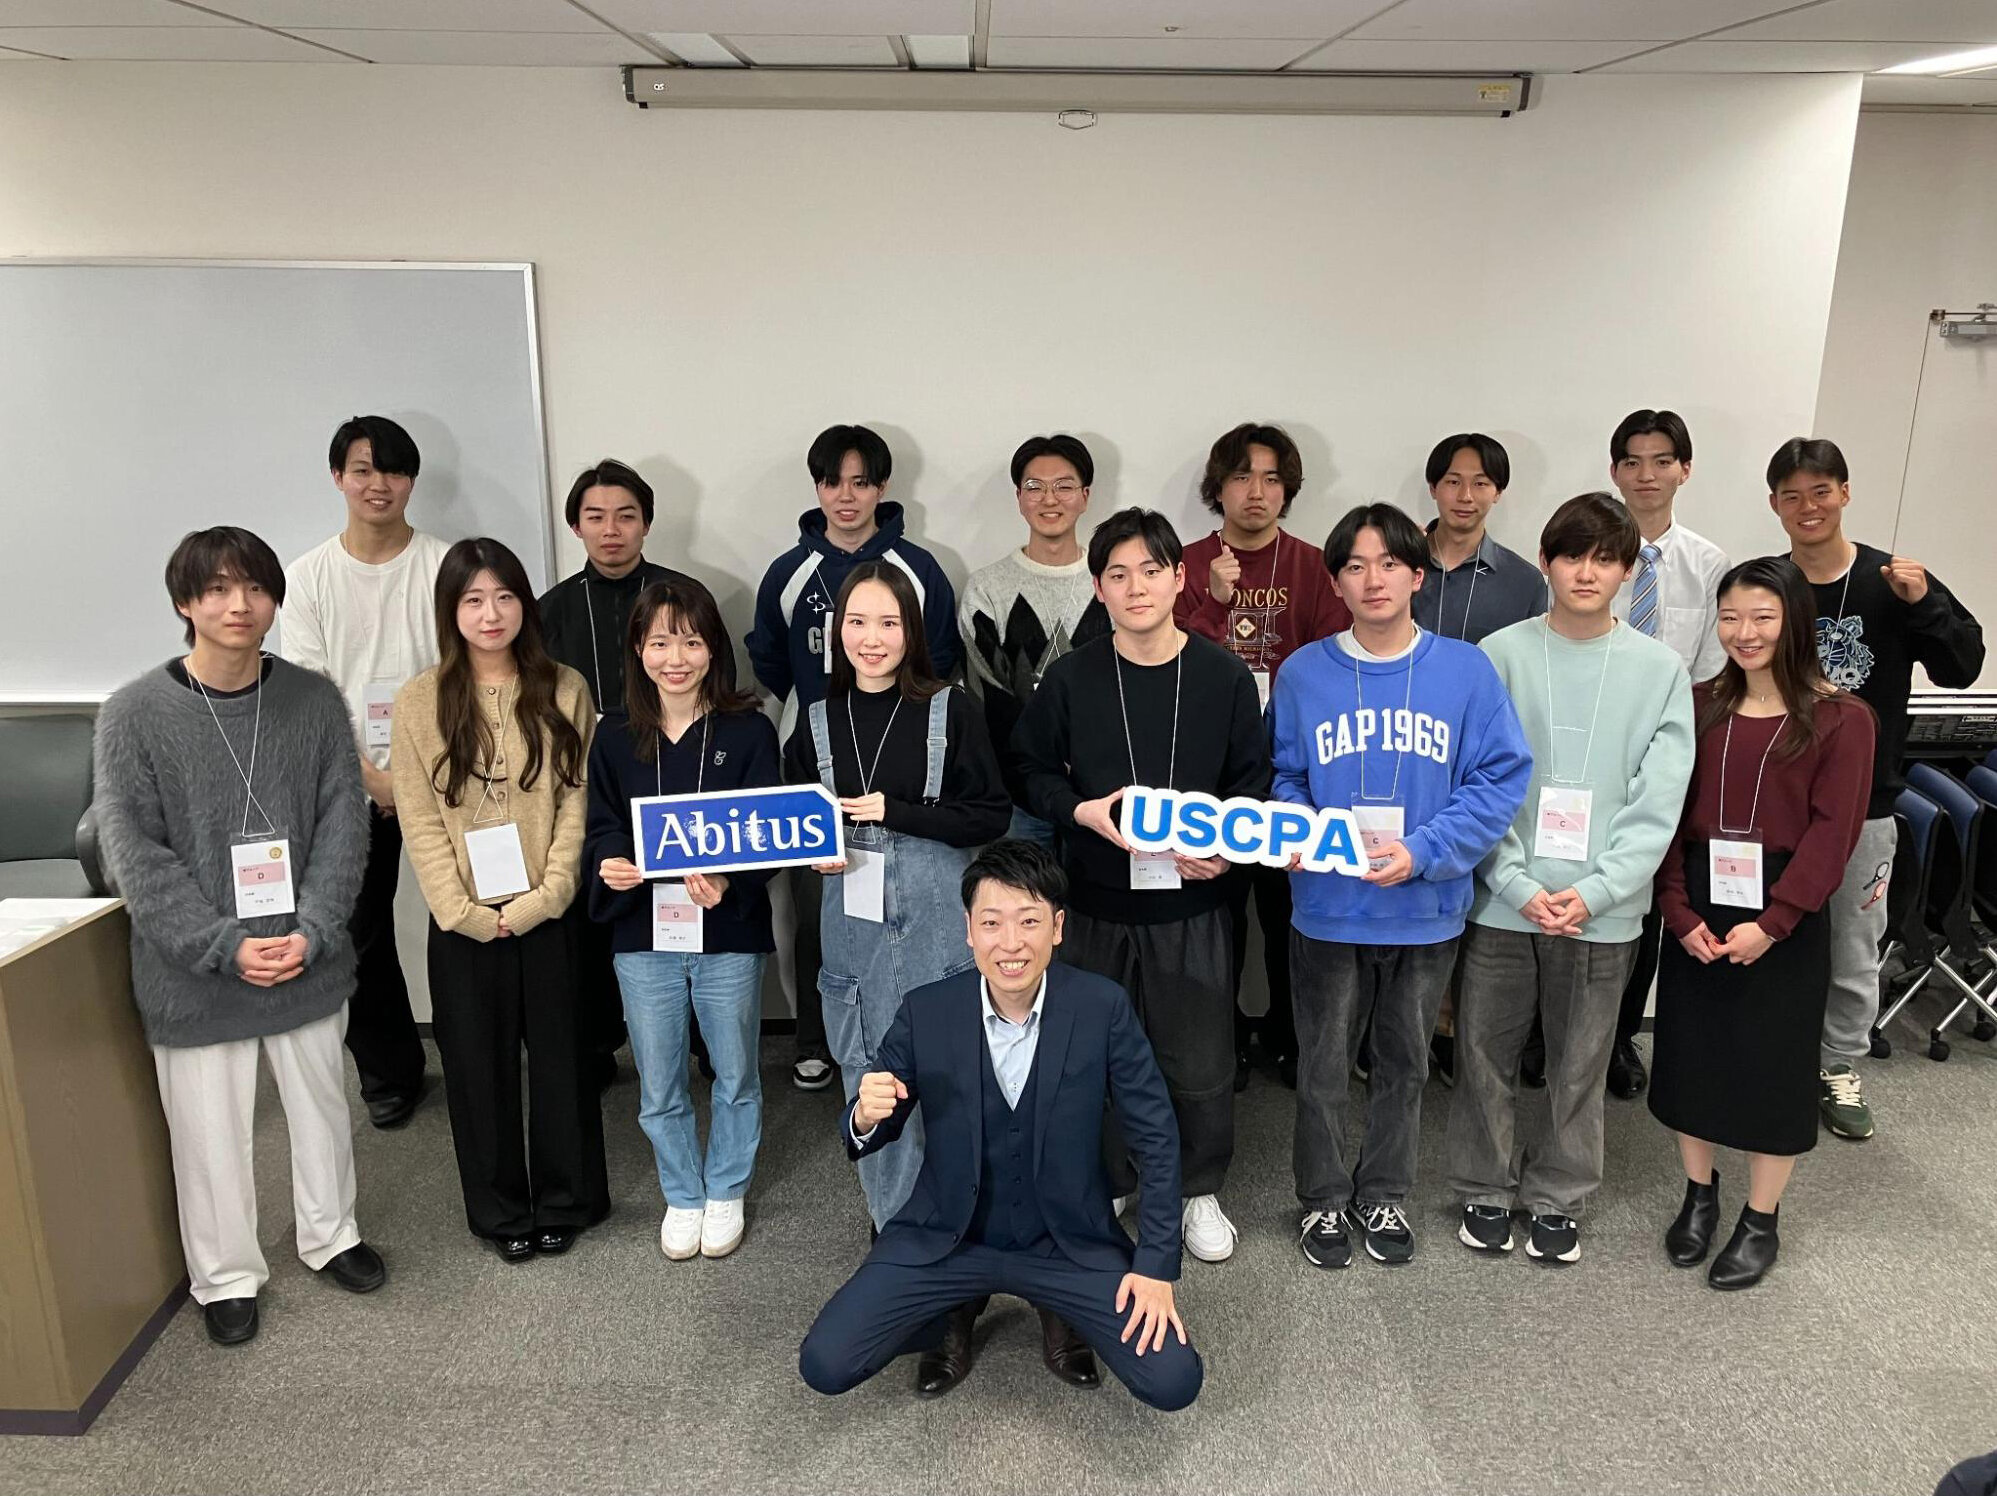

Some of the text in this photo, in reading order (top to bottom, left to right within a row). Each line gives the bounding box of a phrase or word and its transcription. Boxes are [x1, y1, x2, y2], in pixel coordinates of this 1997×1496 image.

[1205, 587, 1288, 607] ONCOS
[1315, 708, 1449, 765] GAP 1969
[655, 807, 826, 860] Abitus
[1131, 795, 1359, 866] USCPA
[1559, 820, 1566, 828] C
[1372, 837, 1379, 845] C
[673, 911, 680, 919] D
